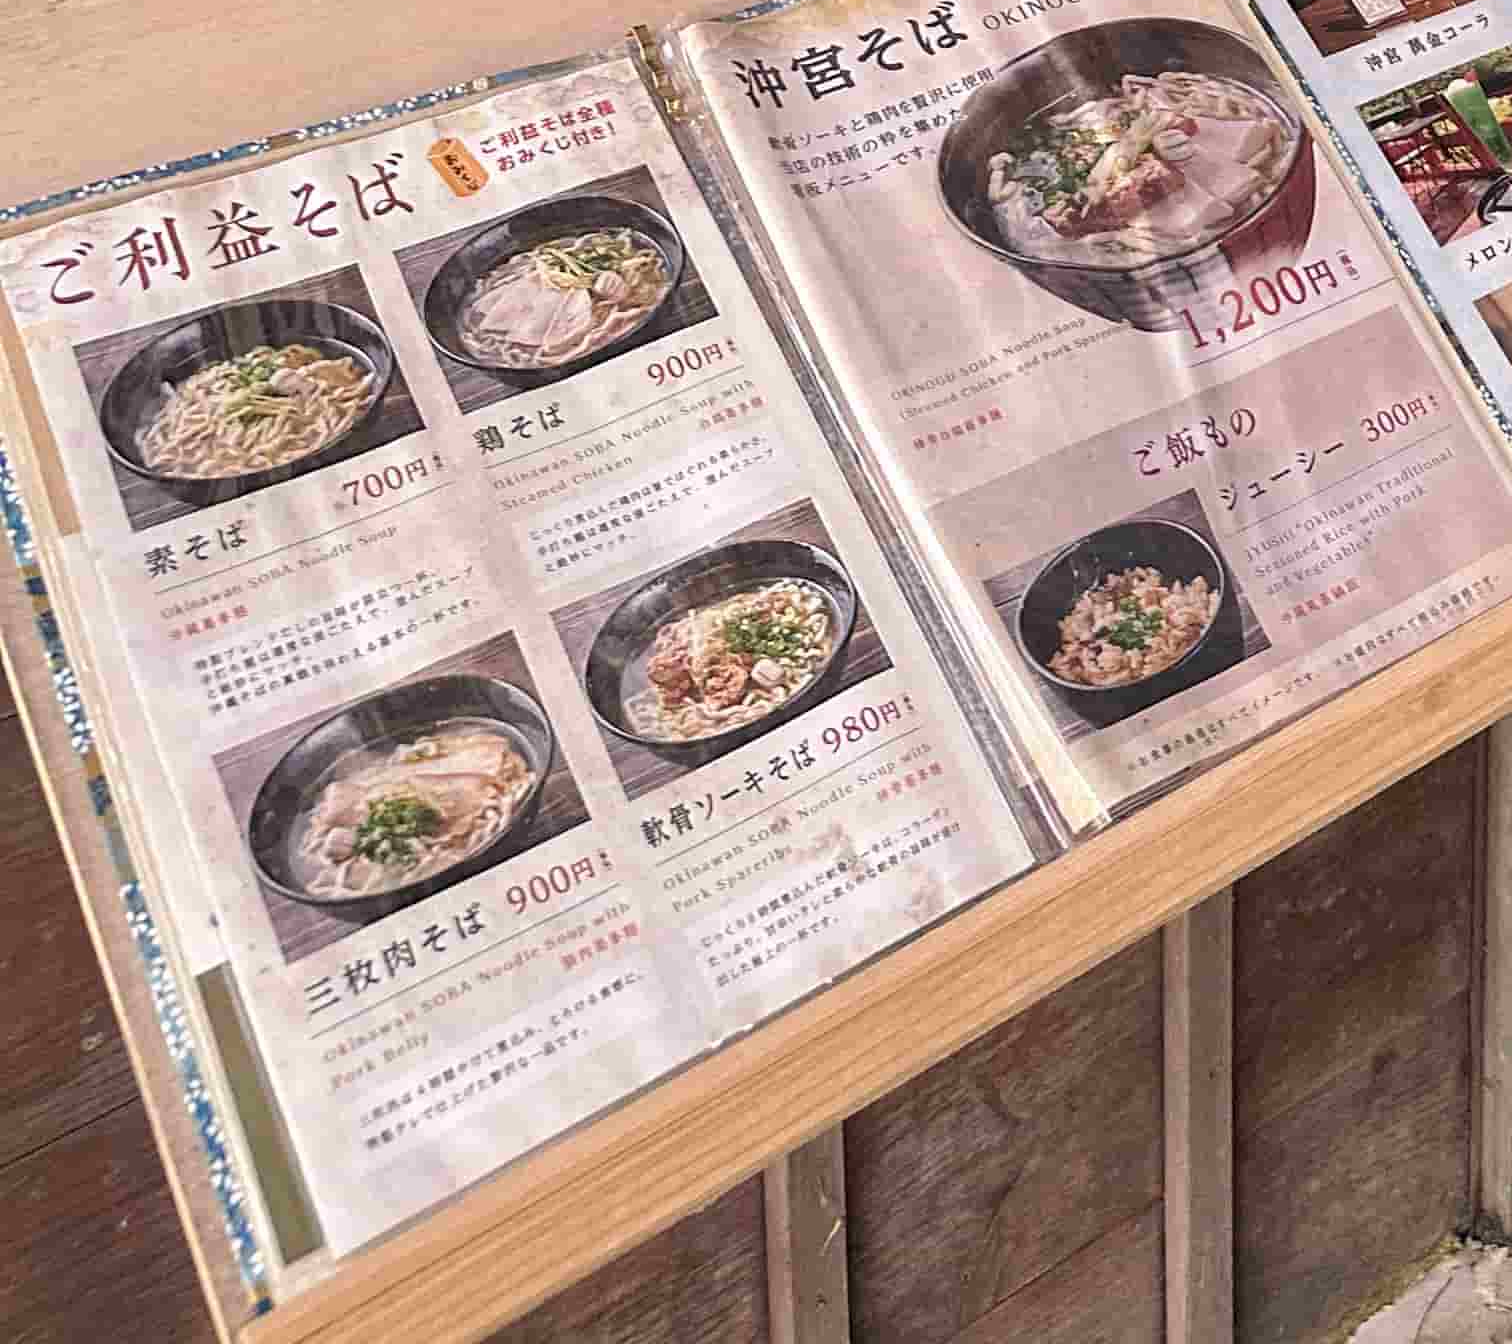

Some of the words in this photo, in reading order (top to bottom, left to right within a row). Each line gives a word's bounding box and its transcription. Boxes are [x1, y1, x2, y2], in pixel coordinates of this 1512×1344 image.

[731, 0, 968, 110] 沖宮そば
[40, 153, 414, 305] ご利益そば
[1180, 259, 1338, 350] 1,200円
[647, 344, 723, 386] 900円
[473, 401, 566, 455] 鶏そば
[1133, 408, 1256, 477] ご飯もの
[1359, 395, 1429, 443] 300円
[341, 458, 428, 506] 700円
[1218, 441, 1345, 510] ジューシー
[143, 520, 248, 579] 素そば
[821, 698, 901, 755] 980円
[640, 740, 817, 849] 軟骨ソーキそば
[505, 857, 596, 915] 900円
[304, 901, 486, 1016] 三枚肉そば
